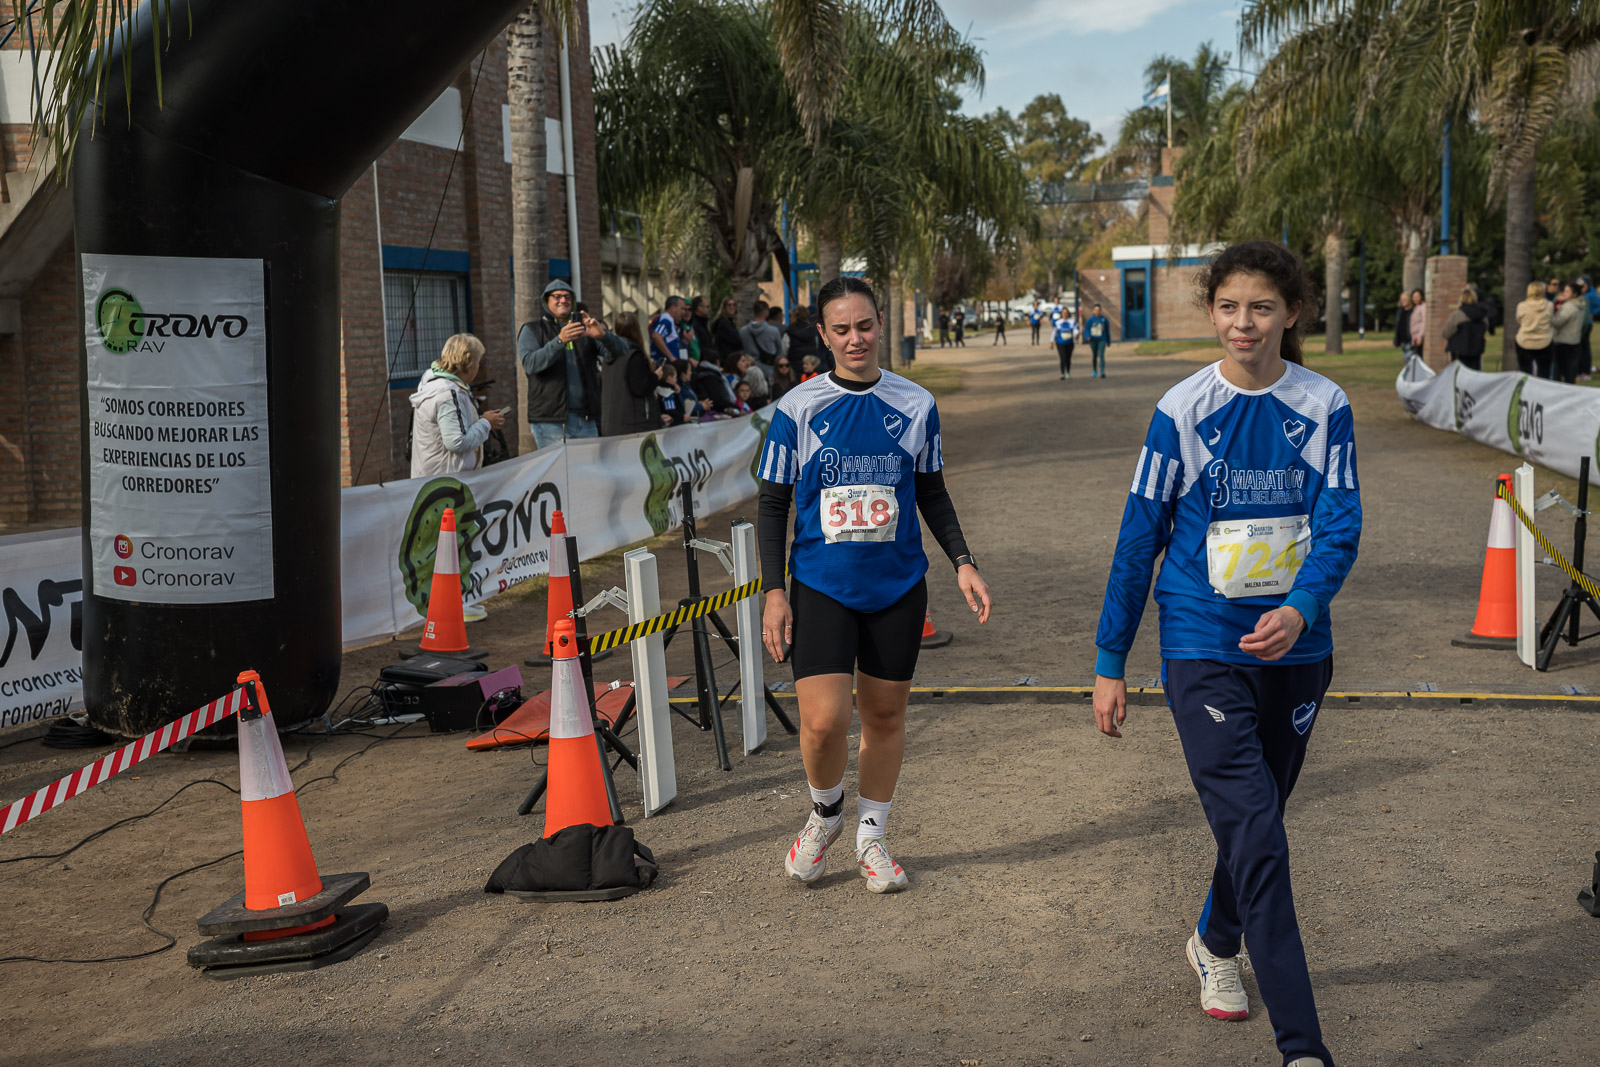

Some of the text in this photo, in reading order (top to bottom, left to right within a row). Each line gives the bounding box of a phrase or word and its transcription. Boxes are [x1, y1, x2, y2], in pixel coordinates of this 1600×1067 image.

[129, 312, 248, 339] CRONO
[126, 340, 166, 353] RAV
[148, 401, 246, 417] CORREDORES
[94, 421, 259, 443] BUSCANDO MEJORAR LAS
[103, 448, 246, 468] EXPERIENCIAS DE LOS
[820, 447, 902, 488] 3 MARATÓN
[1209, 459, 1305, 509] 3 MARATÓN
[828, 499, 891, 527] 518
[141, 541, 235, 560] Cronorav
[1218, 539, 1301, 580] 724
[142, 568, 236, 587] Cronorav
